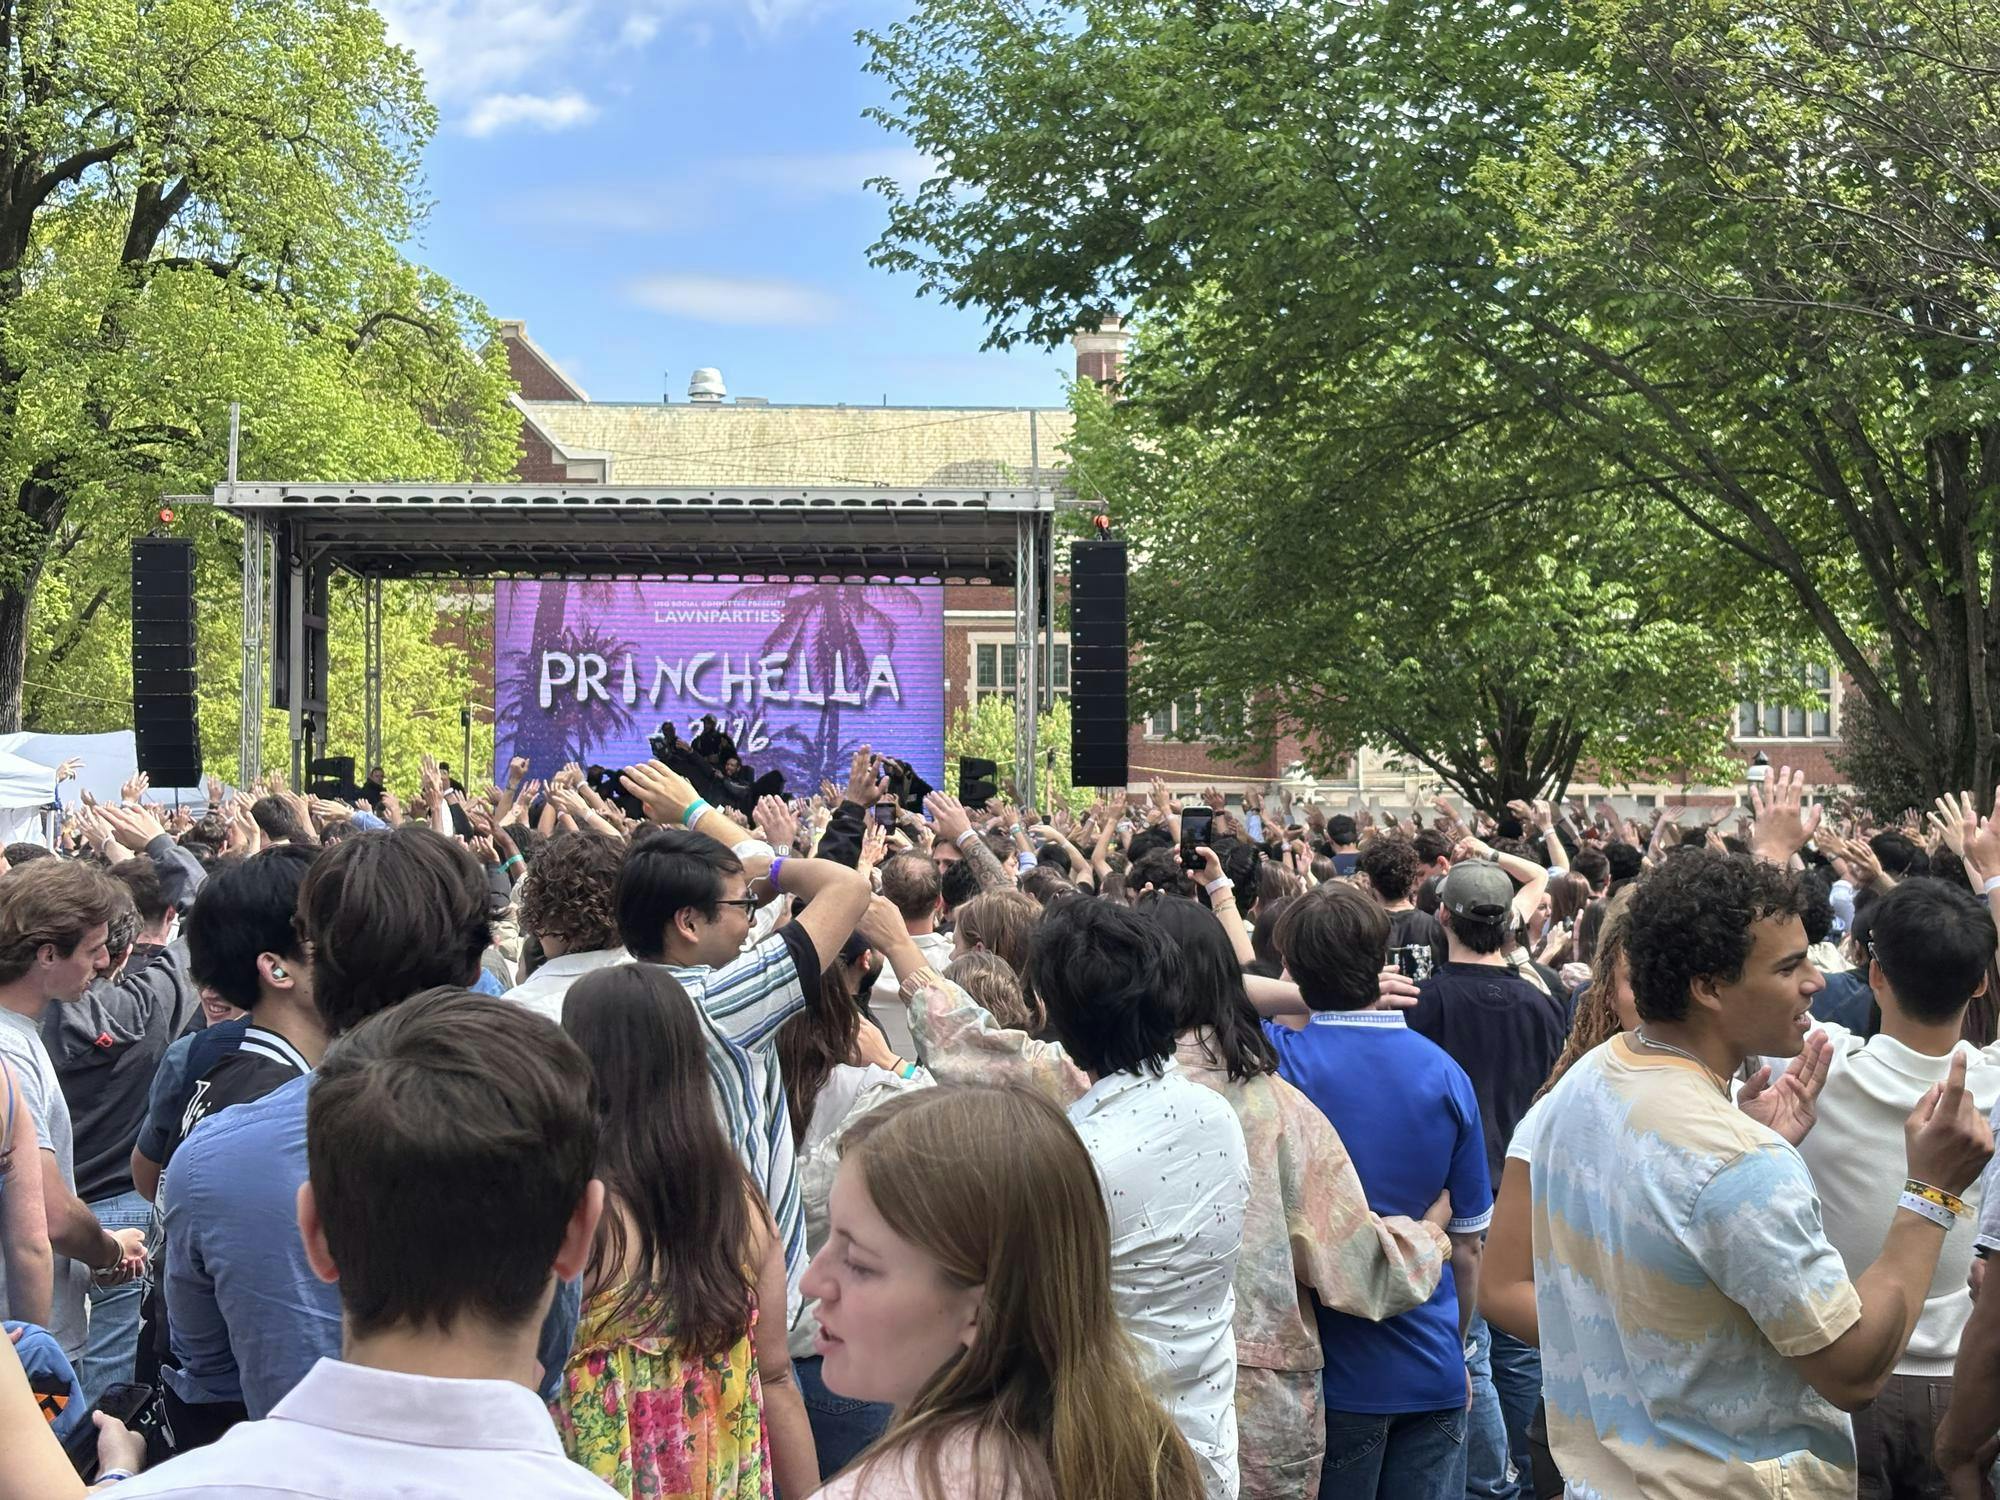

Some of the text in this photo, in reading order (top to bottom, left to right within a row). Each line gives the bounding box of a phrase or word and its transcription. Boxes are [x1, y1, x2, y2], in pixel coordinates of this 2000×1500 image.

[654, 600, 786, 608] USG SOCIAL COMMITTEE PRESENTS
[654, 609, 786, 623] LAWNPARTIES:
[540, 649, 900, 710] PRINCHELLA
[688, 718, 770, 752] 216
